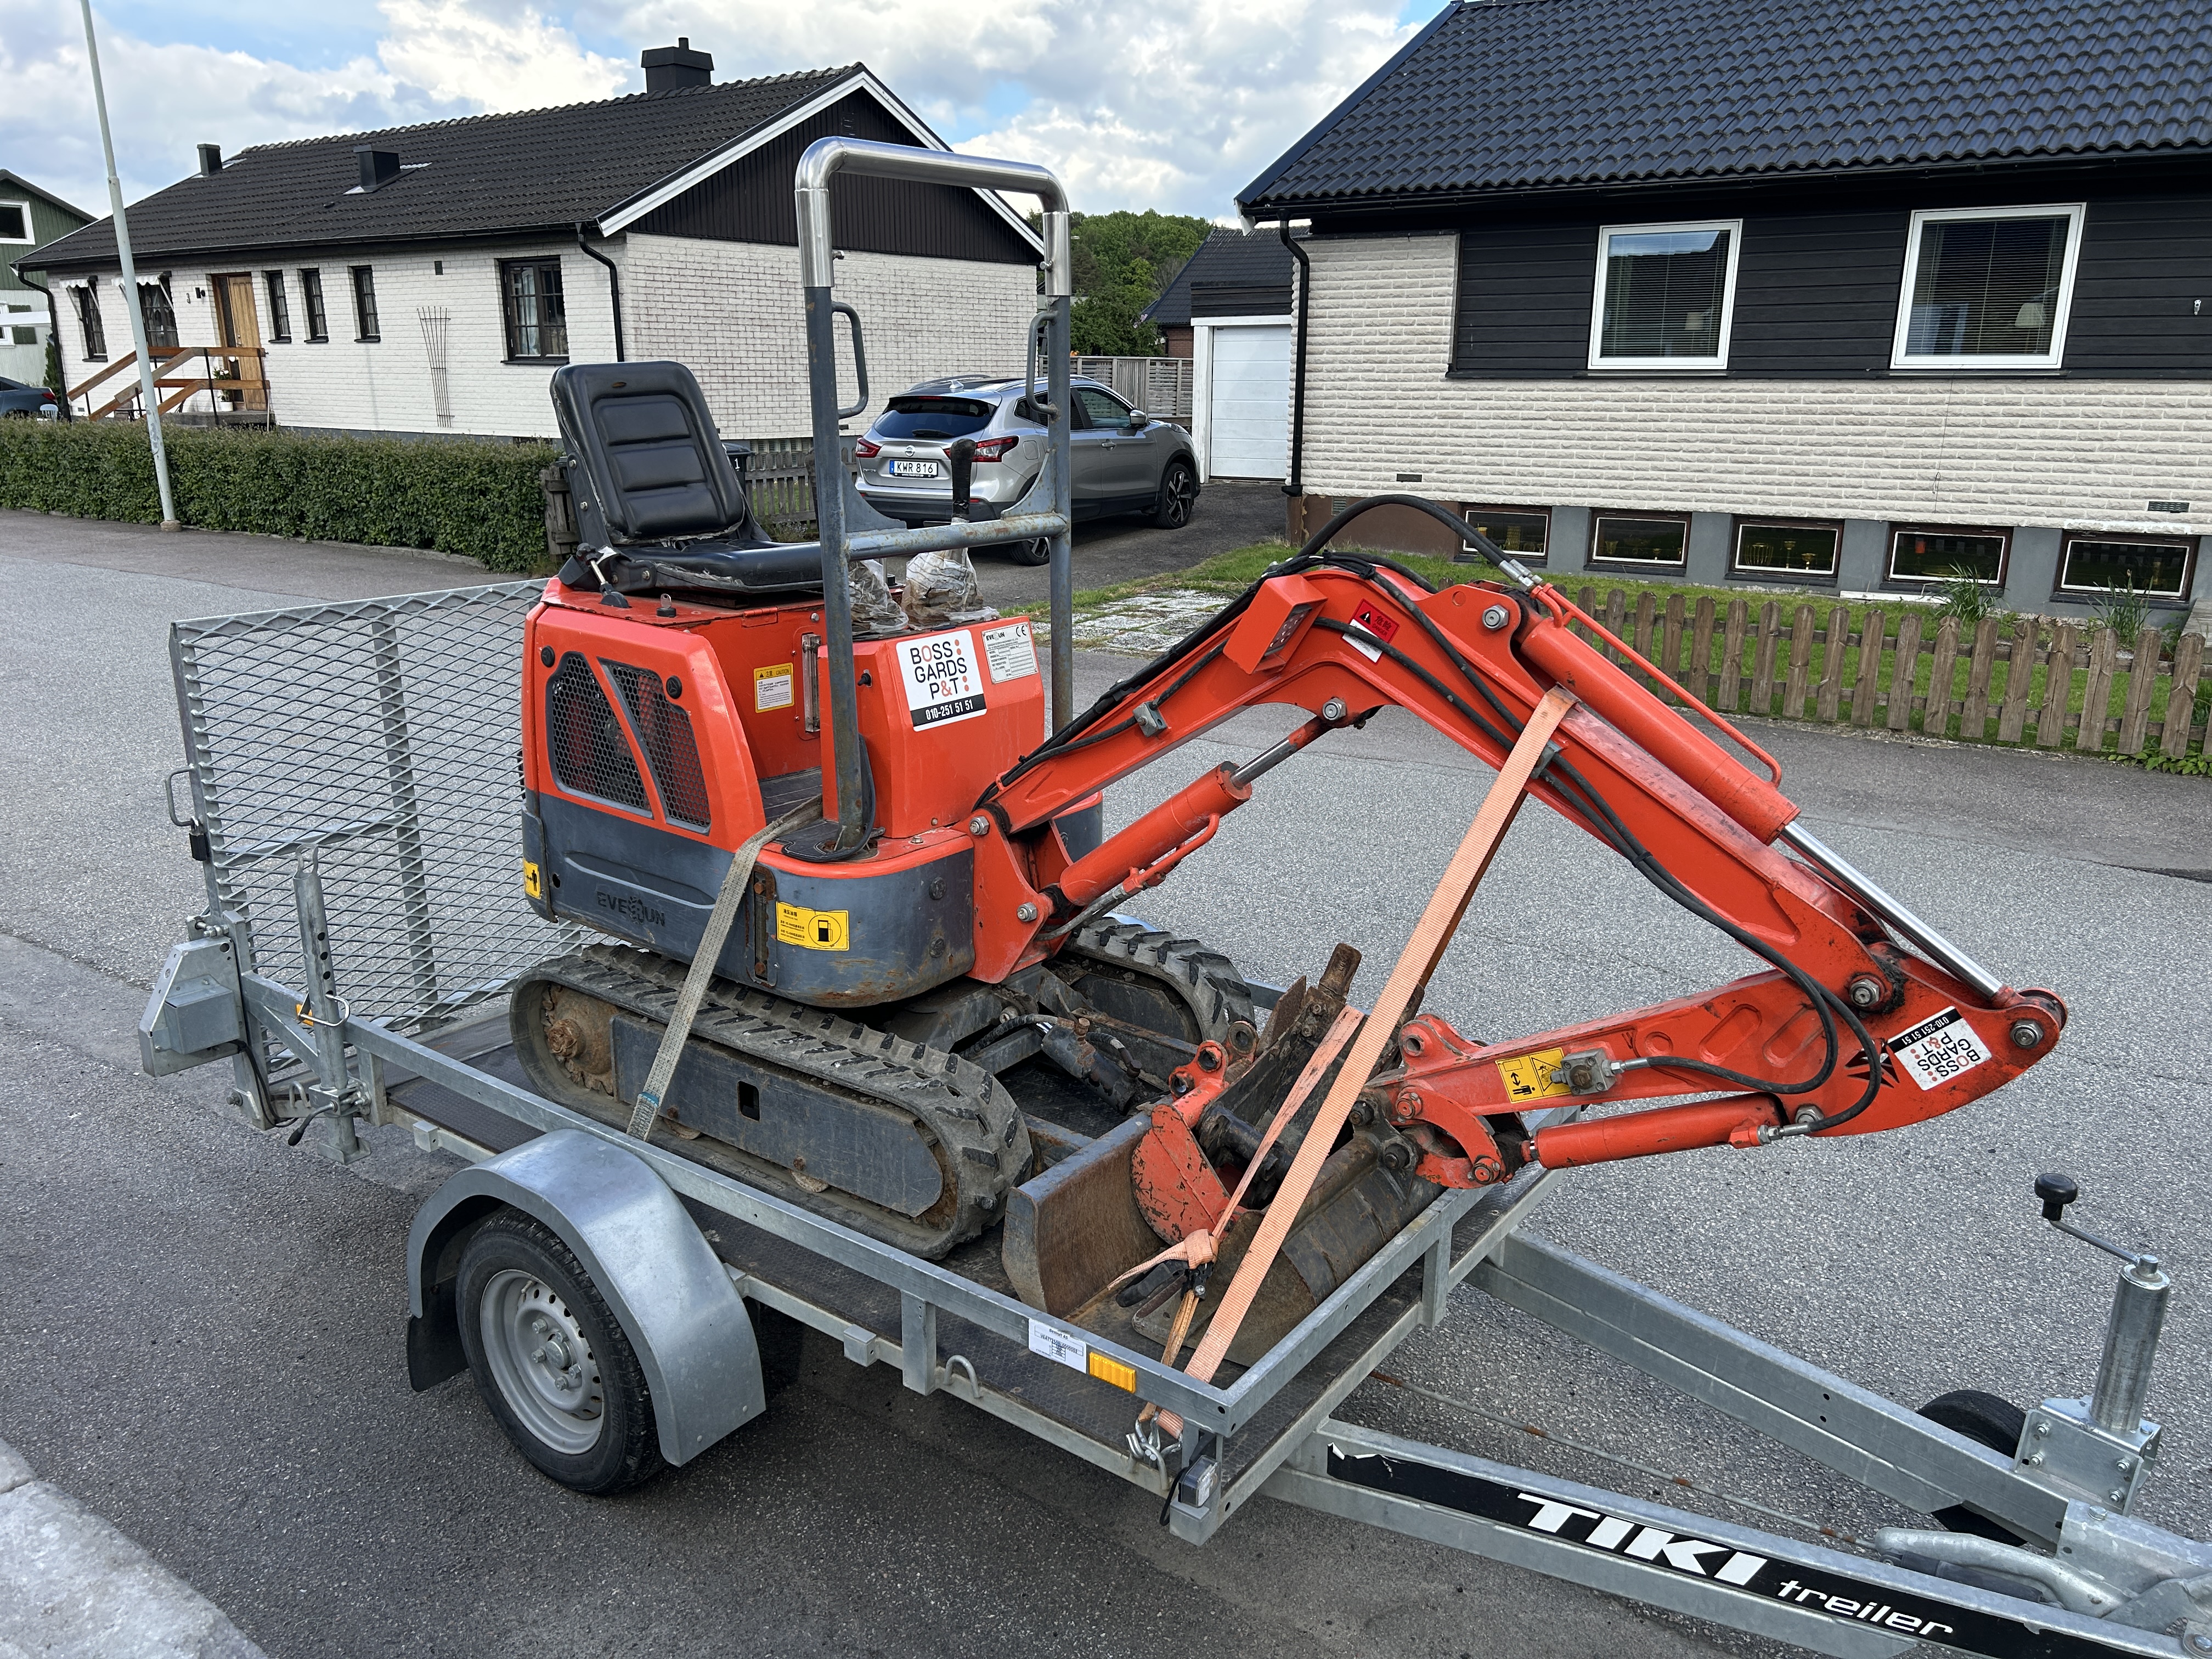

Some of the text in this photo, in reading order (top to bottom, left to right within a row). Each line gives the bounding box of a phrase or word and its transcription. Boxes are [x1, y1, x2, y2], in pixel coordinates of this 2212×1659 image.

[897, 462, 933, 473] KWR 816
[915, 657, 967, 683] GARDS
[926, 699, 973, 721] 010-251 51 51
[1902, 1017, 1950, 1045] 010-251 51 51
[1917, 1039, 1971, 1071] GARDS
[1517, 1492, 1954, 1638] TIKI treiler
